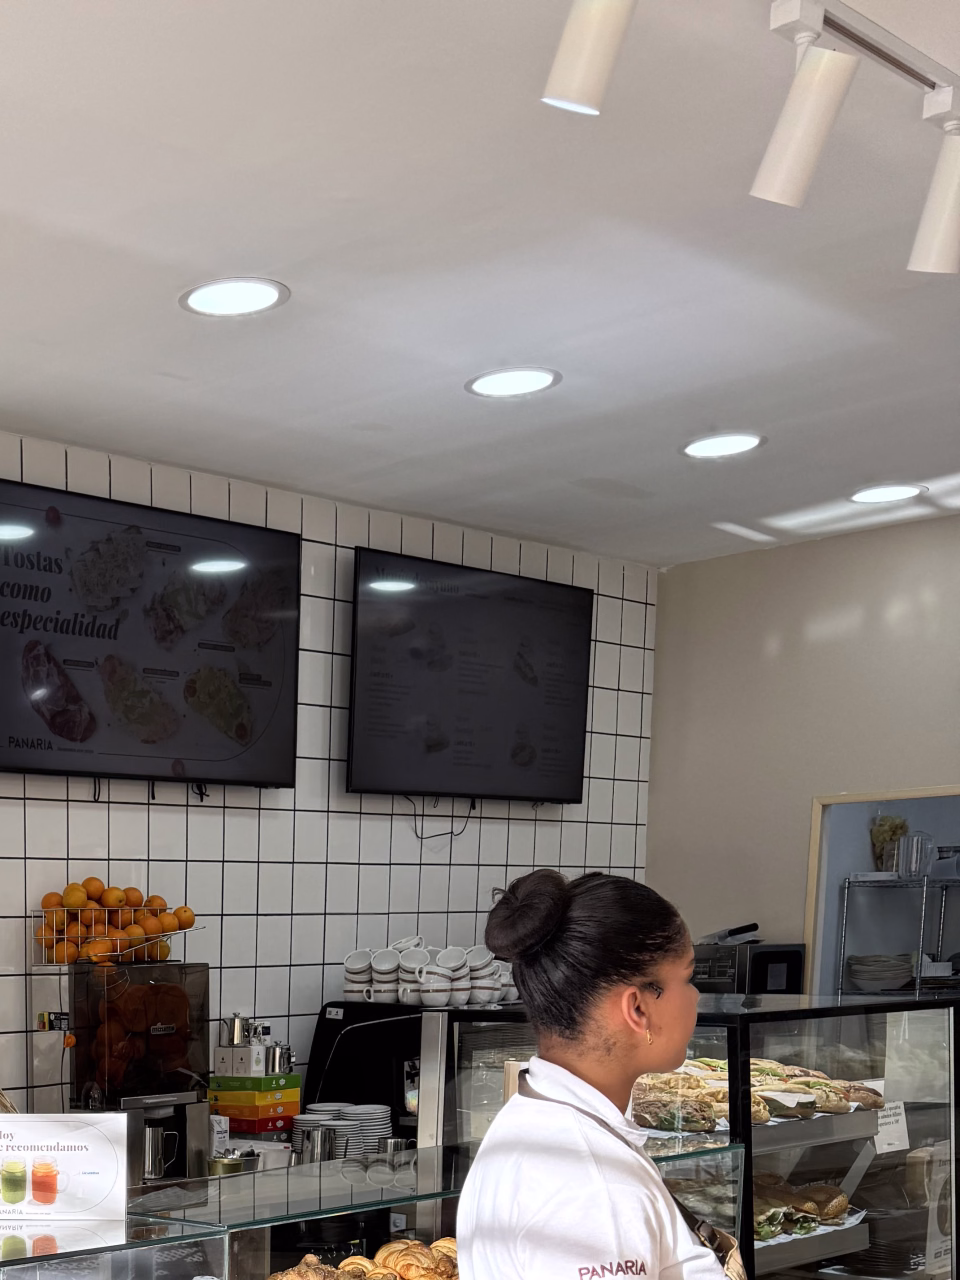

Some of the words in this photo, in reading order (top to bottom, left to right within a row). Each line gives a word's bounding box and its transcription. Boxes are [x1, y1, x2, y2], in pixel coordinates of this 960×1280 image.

[0, 545, 64, 575] Tostas
[0, 580, 52, 603] como
[0, 608, 121, 641] especialidad
[8, 736, 54, 752] PANARIA
[5, 1141, 89, 1152] recomendamos
